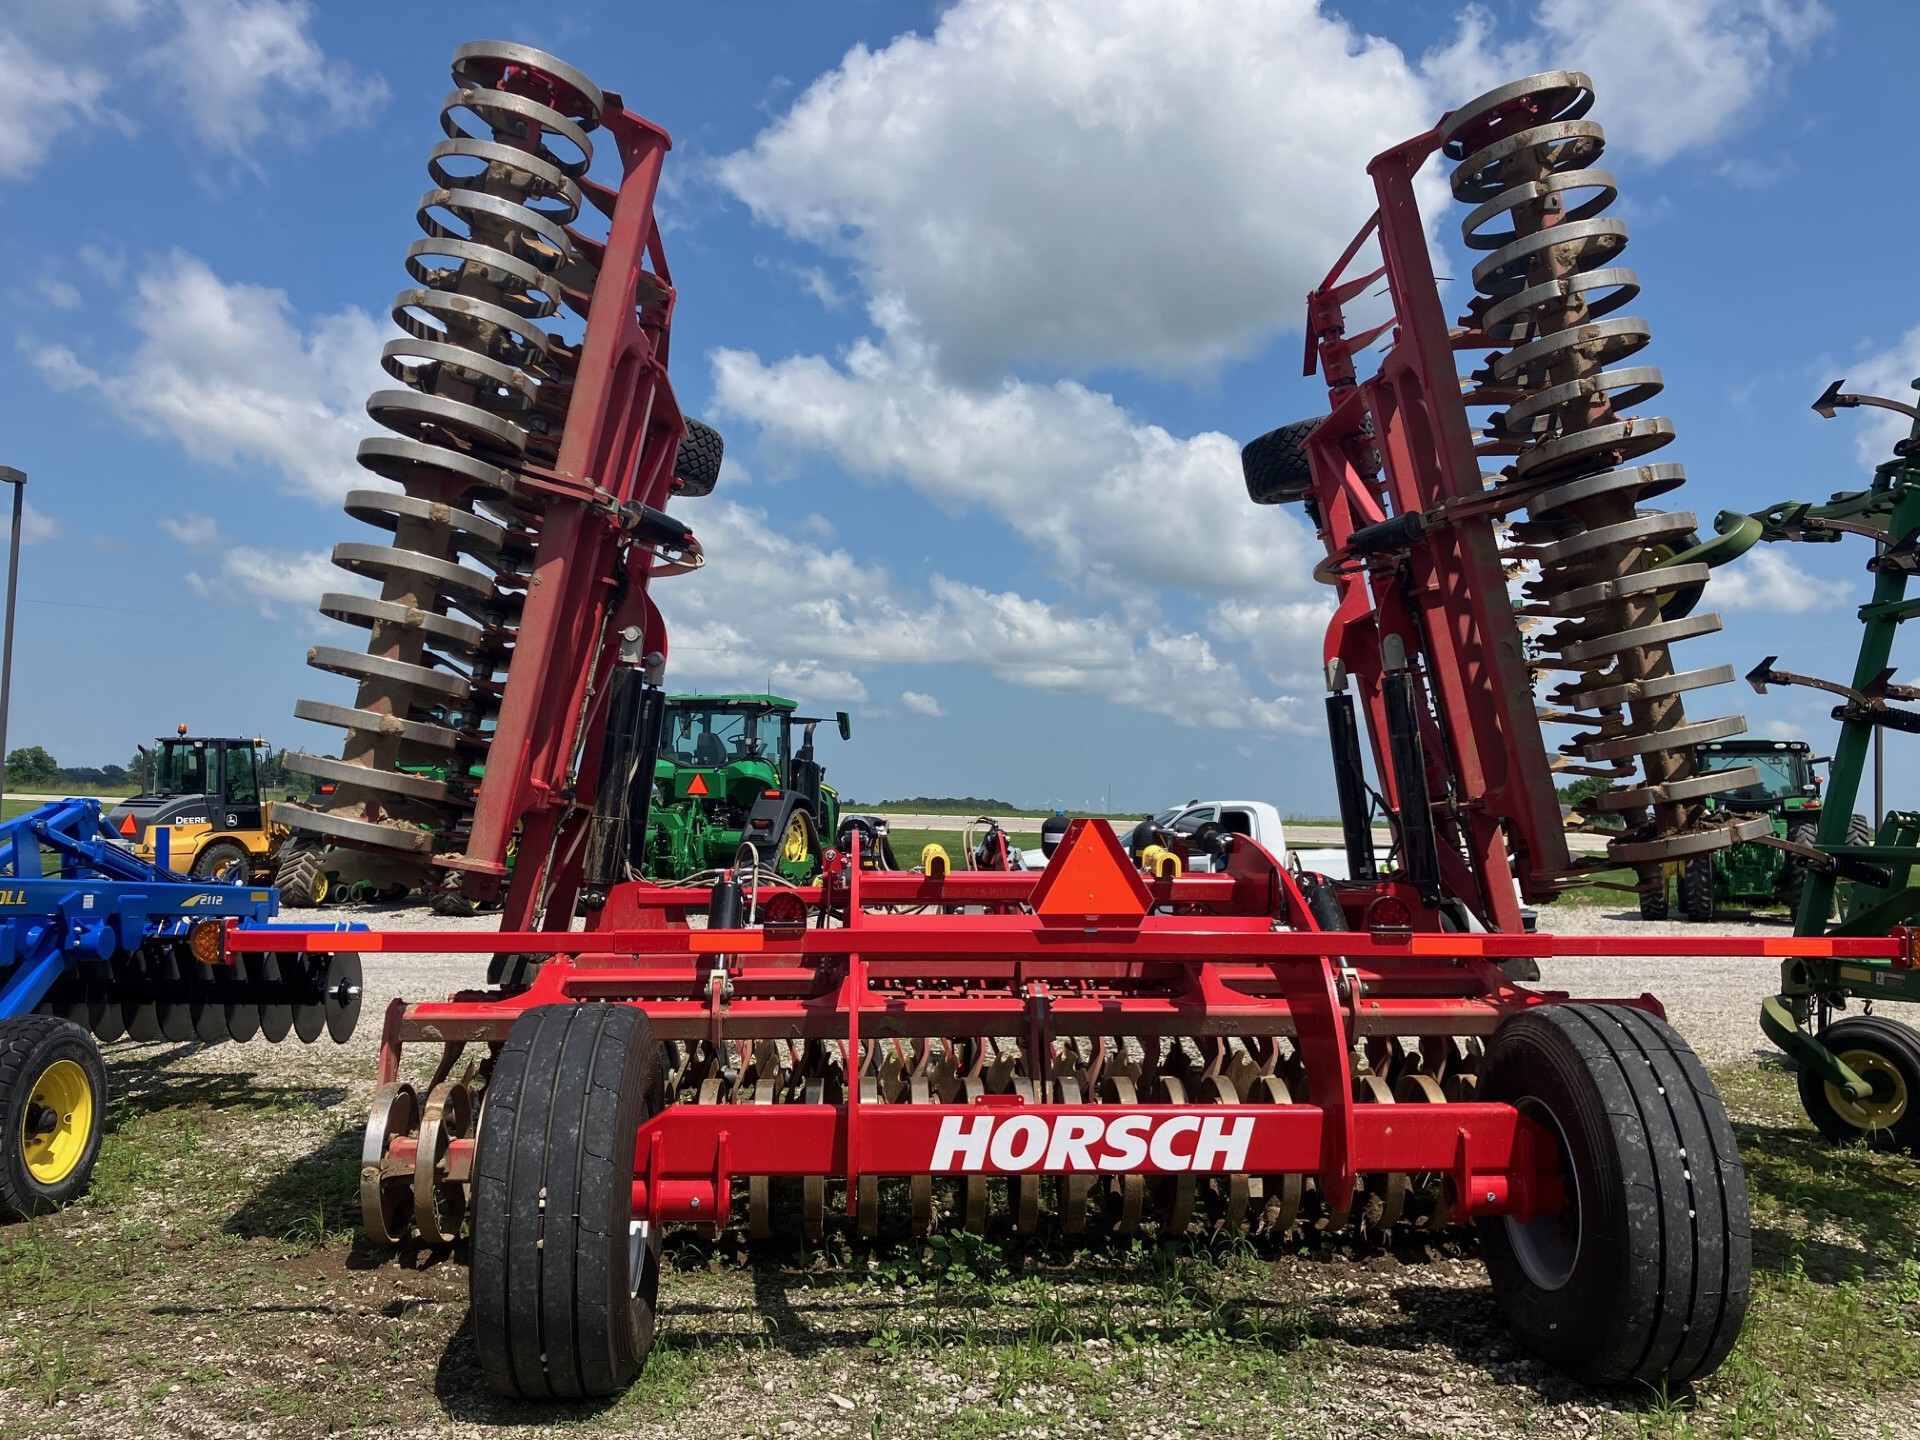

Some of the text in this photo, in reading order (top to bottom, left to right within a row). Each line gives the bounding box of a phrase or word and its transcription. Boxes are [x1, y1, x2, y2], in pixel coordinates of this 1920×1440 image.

[175, 816, 207, 824] DEERE
[200, 895, 223, 905] 2112
[929, 1115, 1256, 1171] HORSCH
